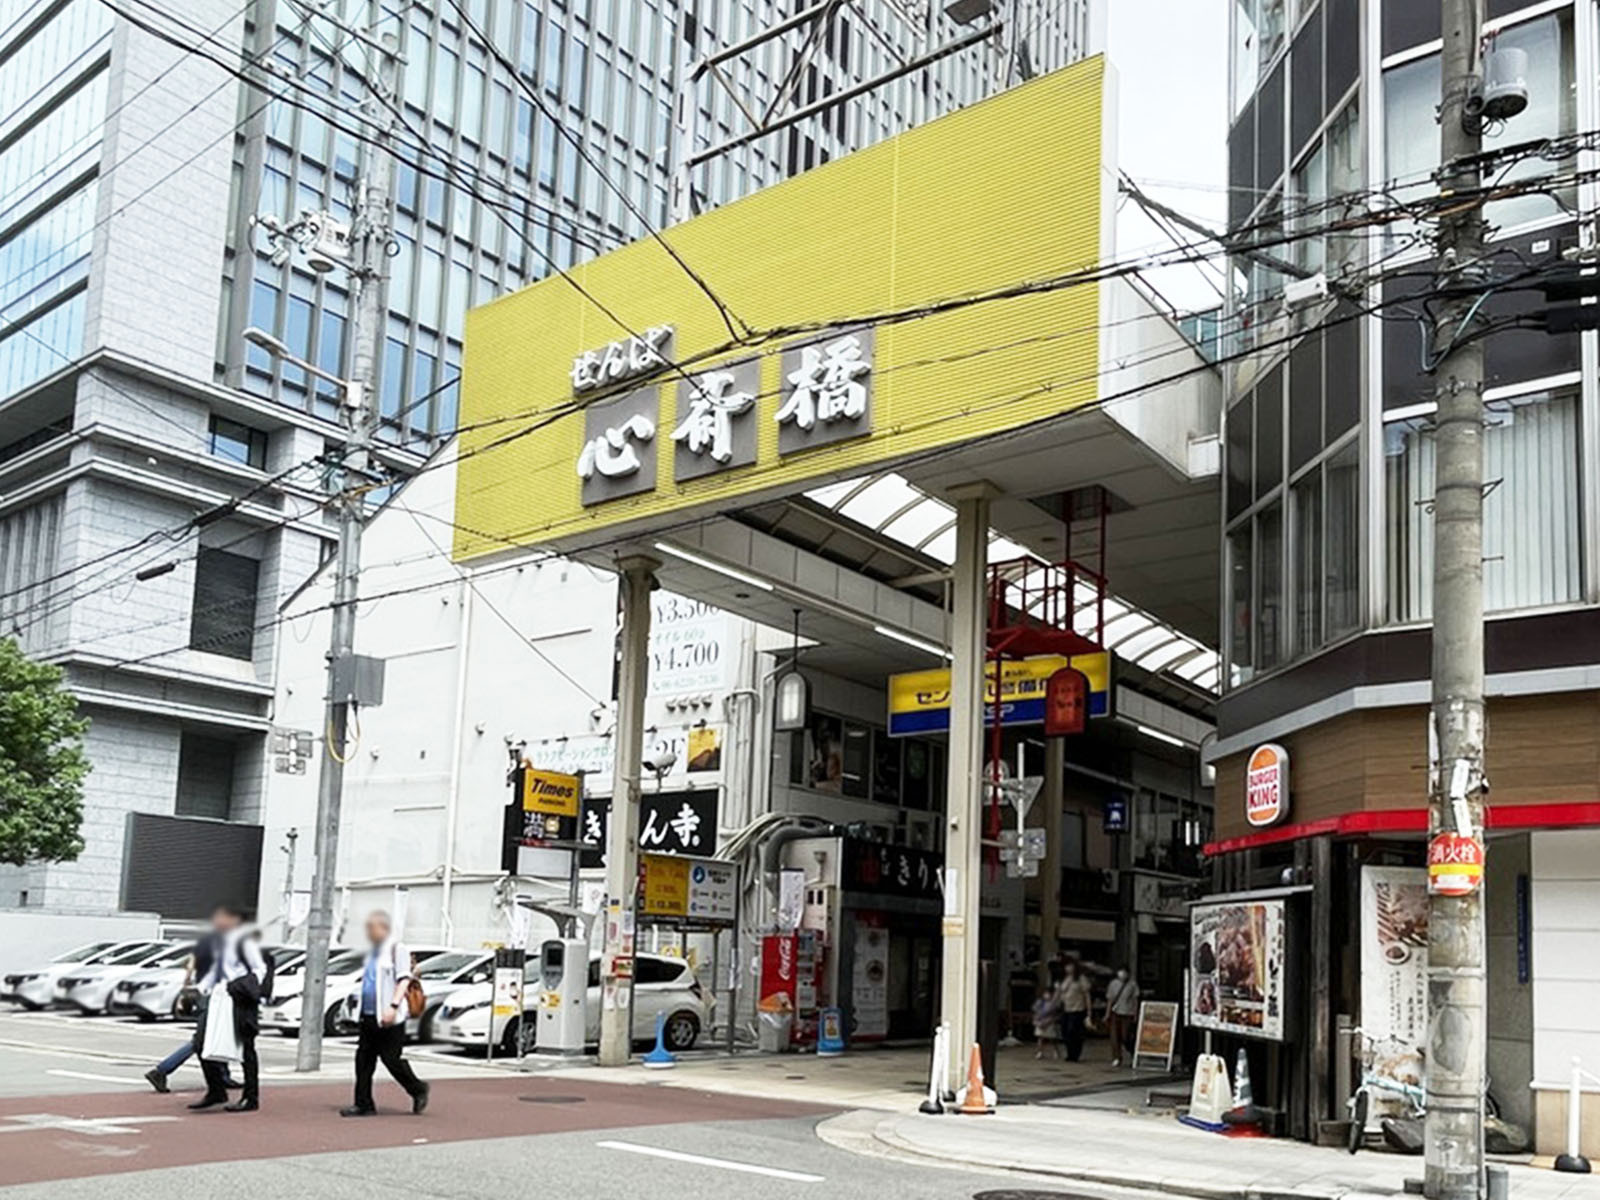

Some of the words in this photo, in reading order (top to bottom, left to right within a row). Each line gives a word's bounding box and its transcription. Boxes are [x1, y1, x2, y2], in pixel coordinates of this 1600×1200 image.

[569, 324, 675, 389] せんば
[531, 777, 575, 798] Times
[1248, 767, 1278, 788] BURGER
[1247, 784, 1279, 809] KING
[1431, 842, 1476, 863] 消火栓
